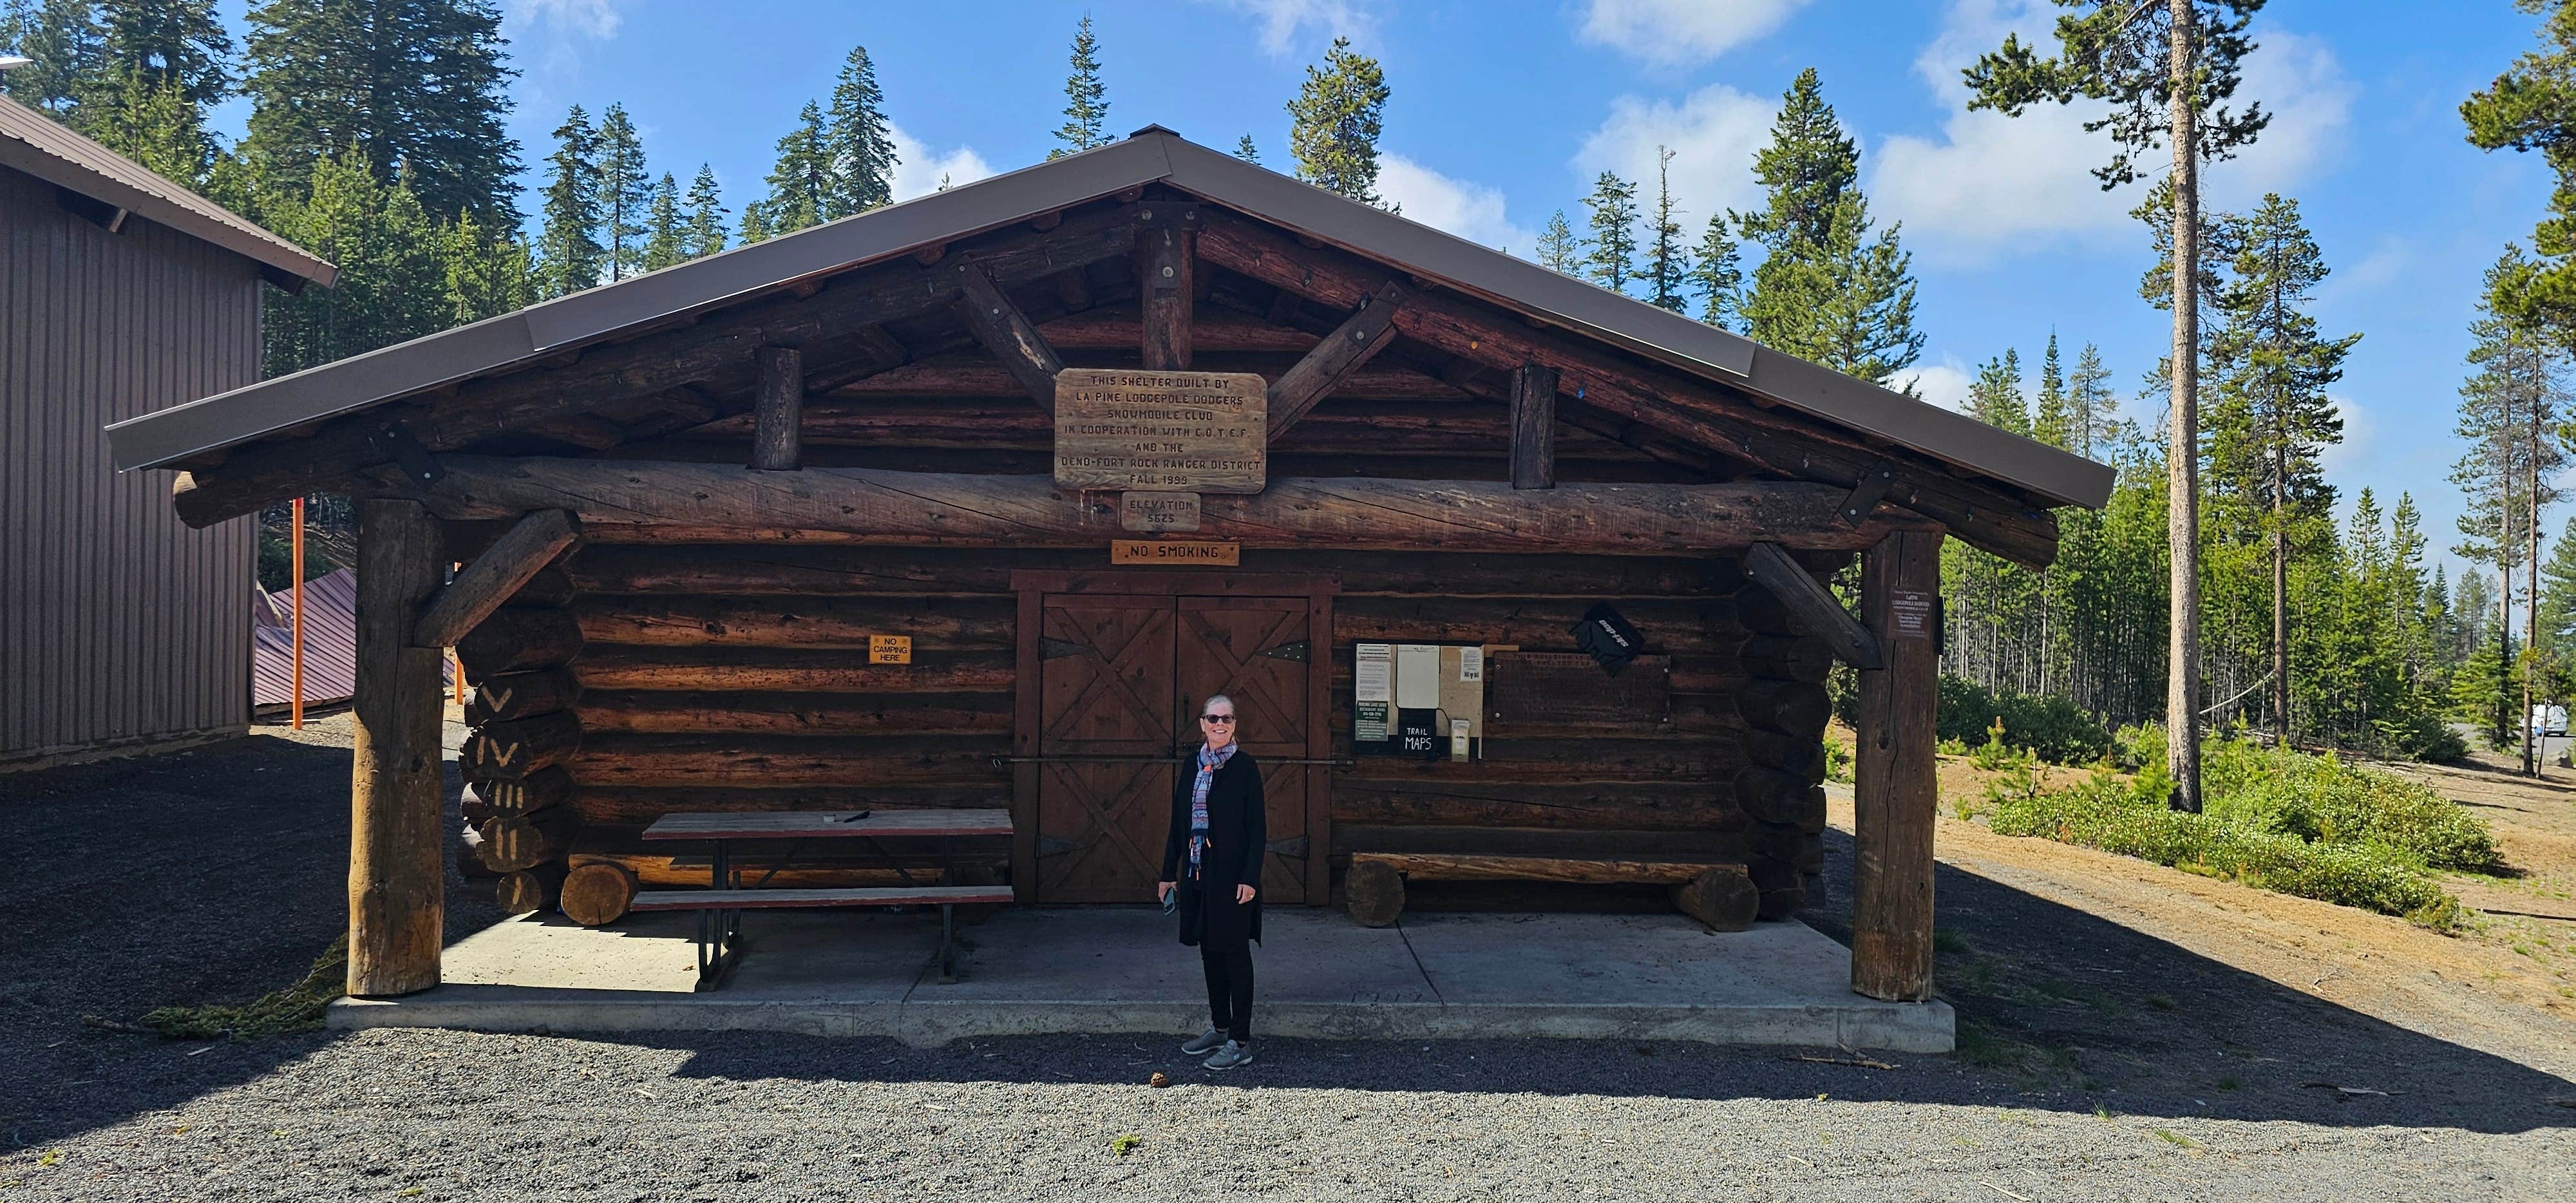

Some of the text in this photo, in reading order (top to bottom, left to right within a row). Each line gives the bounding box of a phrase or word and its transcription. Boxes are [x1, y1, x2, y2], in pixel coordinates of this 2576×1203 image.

[1091, 376, 1229, 389] THIS SHELTER BUILT BY
[1076, 392, 1243, 405] LA PINE LODGEPOLE DODGERS
[1108, 410, 1213, 421] SNOWMOBILE CLUB
[1065, 425, 1251, 438] IN COOPERATION WITH C.O.T.E.F.
[1135, 442, 1183, 452] AND THE
[1062, 457, 1260, 471] BEND-FORT ROCK RANGER DISTRICT
[1130, 475, 1157, 484] FALL
[1130, 500, 1193, 511] ELEVATION
[1147, 514, 1175, 523] 5625
[1130, 545, 1218, 558] NO SMOKING
[873, 645, 907, 654] CAMPING
[481, 687, 513, 712] V
[1406, 727, 1428, 736] TRAIL
[1405, 736, 1432, 751] MAPS
